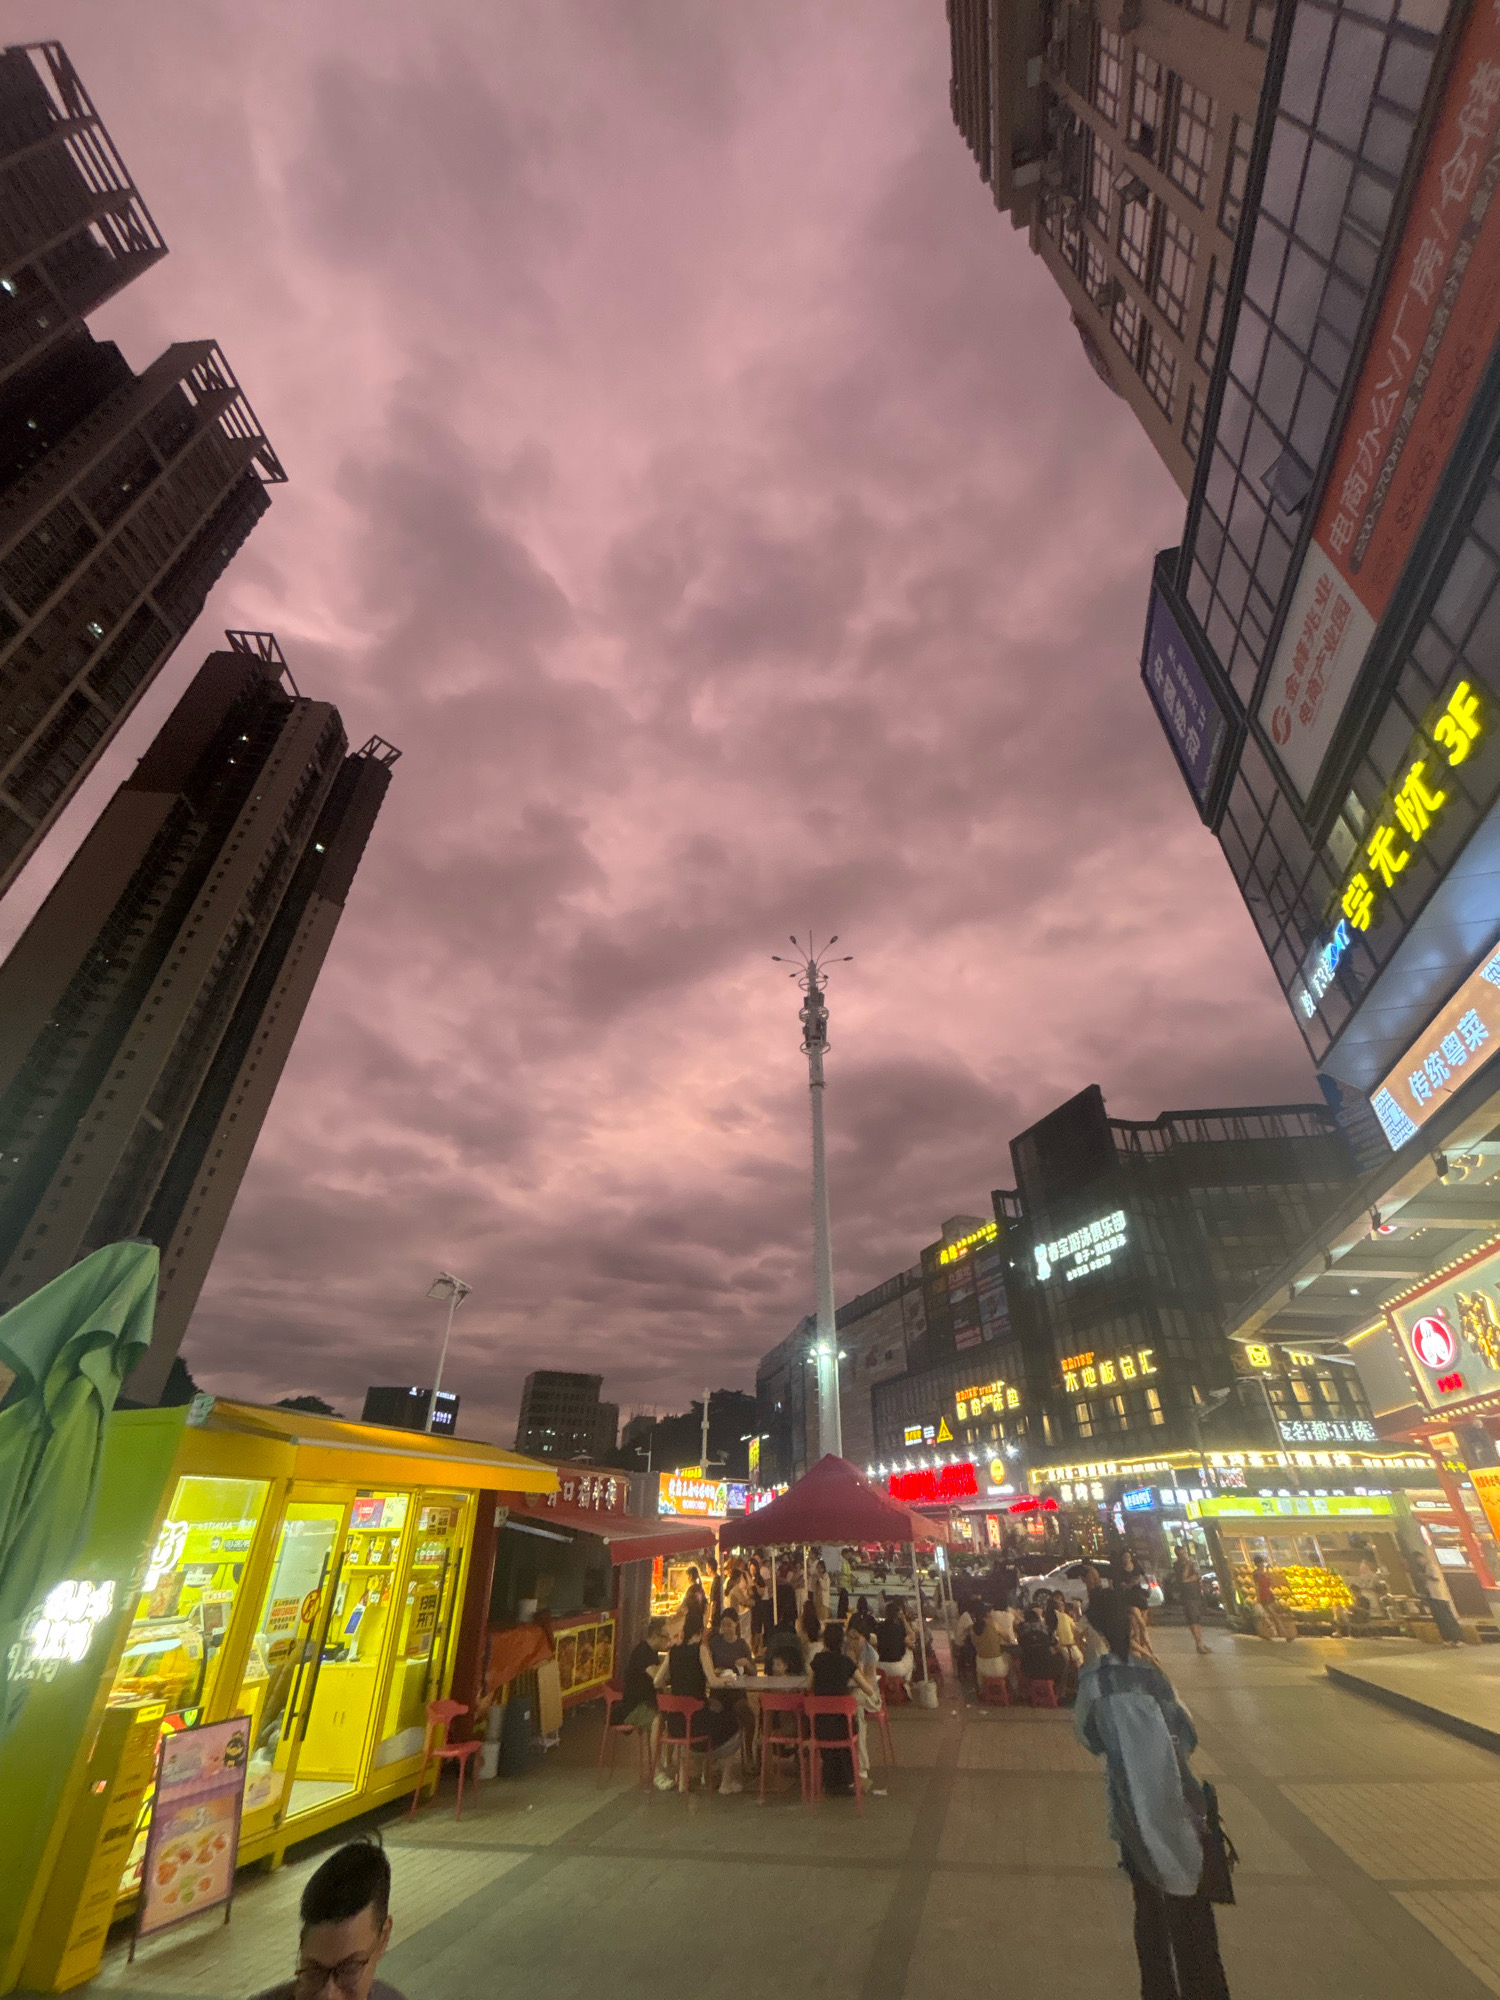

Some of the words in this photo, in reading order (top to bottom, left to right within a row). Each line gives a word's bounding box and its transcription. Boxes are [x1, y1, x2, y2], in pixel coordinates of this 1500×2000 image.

[1342, 760, 1446, 932] 学无忧
[1434, 680, 1480, 767] 3F
[1408, 1008, 1489, 1106] 传统粤菜
[1064, 1350, 1157, 1392] 木地板总汇
[416, 1612, 434, 1629] 开门
[418, 1595, 437, 1611] 扫码
